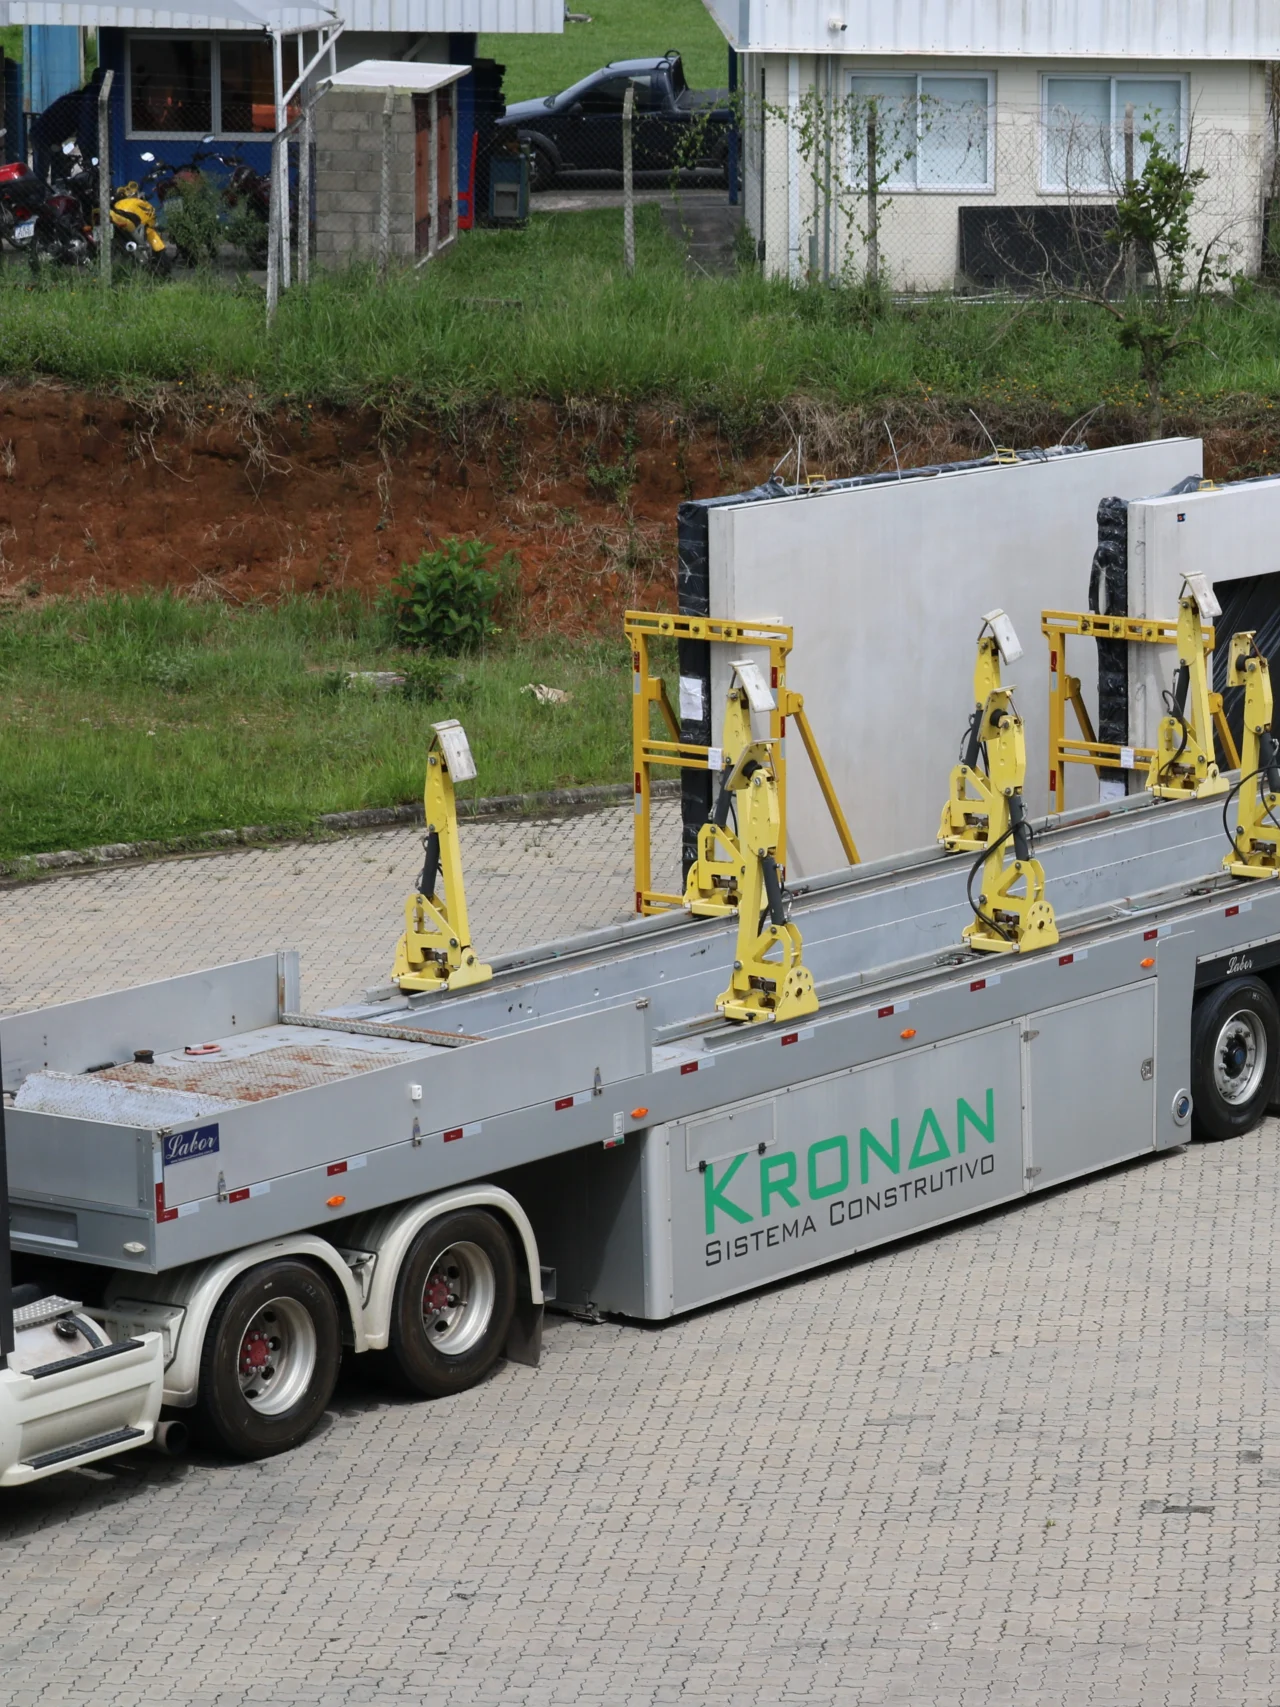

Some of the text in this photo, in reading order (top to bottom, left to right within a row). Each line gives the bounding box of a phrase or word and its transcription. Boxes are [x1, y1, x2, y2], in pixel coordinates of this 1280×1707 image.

[165, 1131, 218, 1160] Labor
[704, 1088, 995, 1235] KRONAN
[705, 1154, 995, 1267] SISTEMA CONSTRUTIVO
